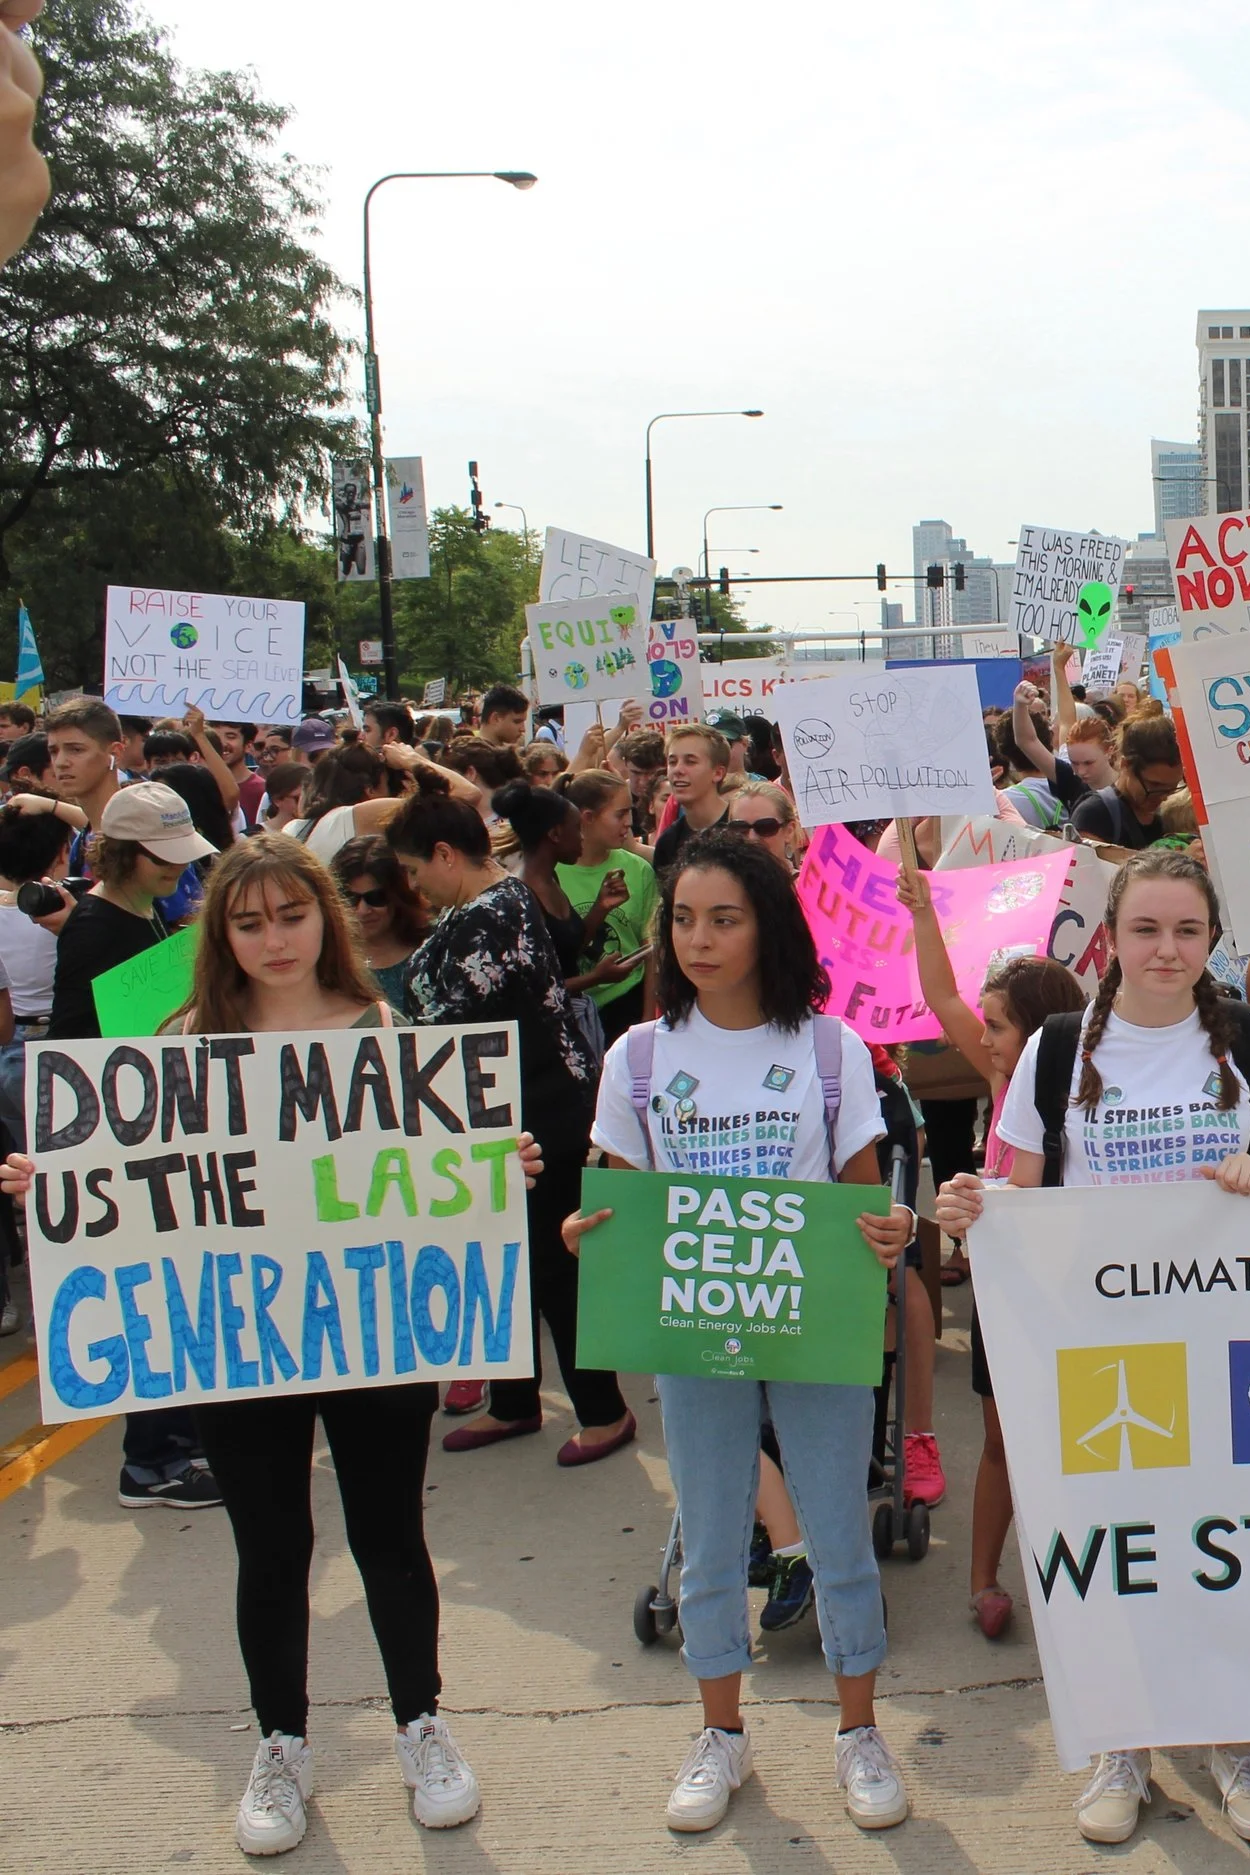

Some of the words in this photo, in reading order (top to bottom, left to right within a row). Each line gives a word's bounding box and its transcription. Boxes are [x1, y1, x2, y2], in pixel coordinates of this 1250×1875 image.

[1023, 529, 1035, 548] I
[1041, 532, 1073, 556] WAS
[1079, 540, 1122, 562] FREED
[560, 538, 609, 576] LET
[614, 557, 648, 590] IT
[1020, 550, 1048, 574] THIS
[1054, 556, 1103, 583] MORNING
[1107, 568, 1118, 585] &
[129, 589, 204, 619] RAISE
[224, 598, 279, 622] YOUR
[1152, 607, 1179, 627] GLOBA
[1015, 601, 1045, 635] TOO
[1049, 608, 1079, 645] HOT
[112, 653, 166, 679] NOT
[174, 658, 212, 680] THE
[222, 659, 259, 681] SEA
[1083, 670, 1116, 681] PLANET!
[649, 697, 688, 719] NO
[800, 766, 858, 813] AIR
[860, 764, 971, 800] POLLUTION
[121, 953, 159, 998] SAVE
[35, 1036, 255, 1153] DON'T
[279, 1030, 514, 1142] MAKE
[678, 1113, 750, 1134] STRIKES
[756, 1110, 800, 1123] BACK
[1083, 1126, 1098, 1139] IL
[1103, 1117, 1185, 1139] STRIKES
[1191, 1112, 1241, 1130] BACK
[1084, 1109, 1099, 1124] IL
[1104, 1104, 1184, 1124] STRIKES
[678, 1128, 750, 1149] STRIKES
[755, 1125, 798, 1143] BACK
[756, 1145, 795, 1158] BACK
[1084, 1140, 1100, 1158] IL
[1104, 1135, 1186, 1158] STRIKES
[1193, 1133, 1241, 1145] BACK
[1088, 1160, 1103, 1172] IL
[1107, 1150, 1186, 1172] STRIKES
[1110, 1168, 1186, 1185] STRIKES
[35, 1168, 120, 1244] US
[124, 1149, 266, 1233] THE
[312, 1137, 519, 1223] LAST
[666, 1185, 806, 1233] PASS
[663, 1230, 805, 1278] CEJA
[661, 1276, 803, 1321] NOW!
[48, 1240, 522, 1410] GENERATION
[660, 1315, 695, 1329] Clean
[698, 1318, 742, 1334] Energy
[746, 1322, 776, 1335] Jobs
[780, 1324, 802, 1336] Act
[1034, 1523, 1158, 1605] WE
